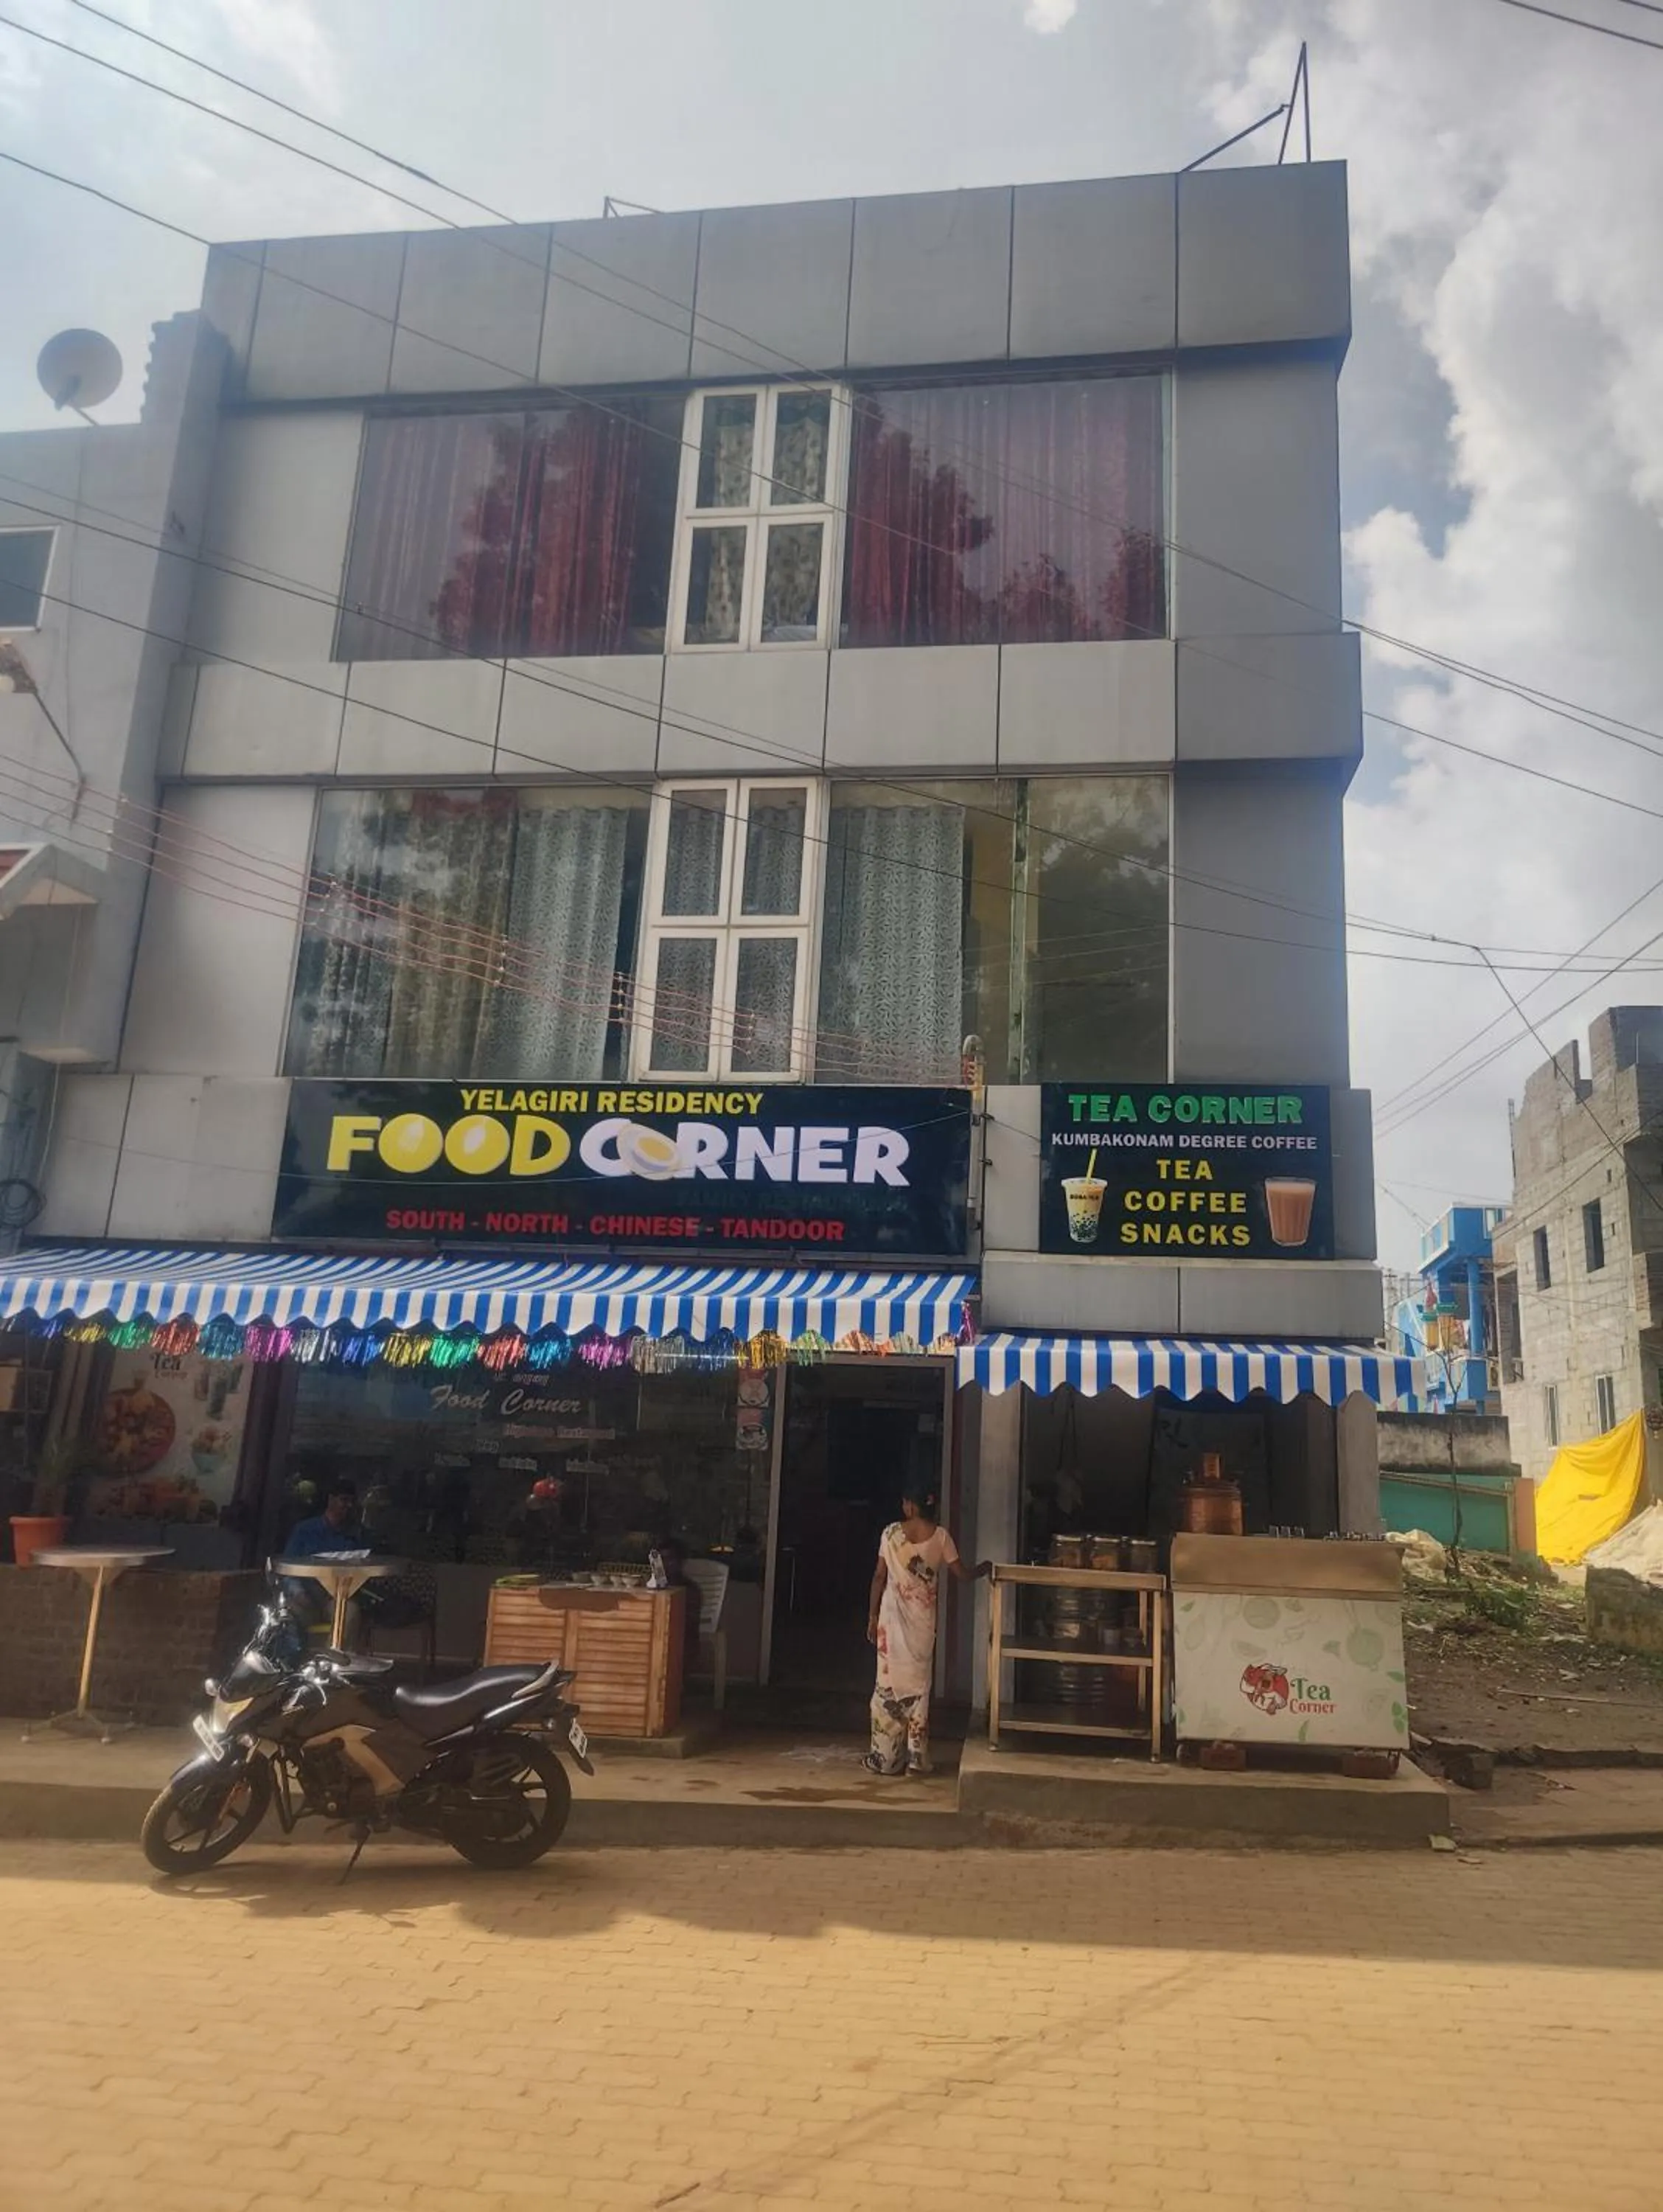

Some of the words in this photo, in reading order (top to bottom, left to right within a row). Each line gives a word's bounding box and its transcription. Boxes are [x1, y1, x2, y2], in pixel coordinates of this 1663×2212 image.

[460, 1088, 589, 1113] YELAGIRI
[596, 1091, 764, 1115] RESIDENCY
[1067, 1093, 1138, 1122] TEA
[1147, 1094, 1304, 1124] CORNER
[326, 1112, 571, 1175] FOOD
[579, 1117, 911, 1186] CORNER
[1051, 1133, 1174, 1147] KUMBAKONAM
[1179, 1135, 1247, 1149] DEGREE
[1251, 1135, 1317, 1150] COFFEE
[1156, 1159, 1213, 1180] TEA
[1124, 1190, 1247, 1214] COFFEE
[386, 1209, 466, 1230] SOUTH
[485, 1213, 569, 1232] NORTH
[590, 1216, 700, 1237] CHINESE
[719, 1219, 844, 1240] TANDOOR
[1120, 1222, 1251, 1246] SNACKS
[430, 1384, 490, 1412] Food
[500, 1388, 582, 1415] Corner
[1289, 1677, 1331, 1700] Tea
[1289, 1698, 1336, 1714] Corner
